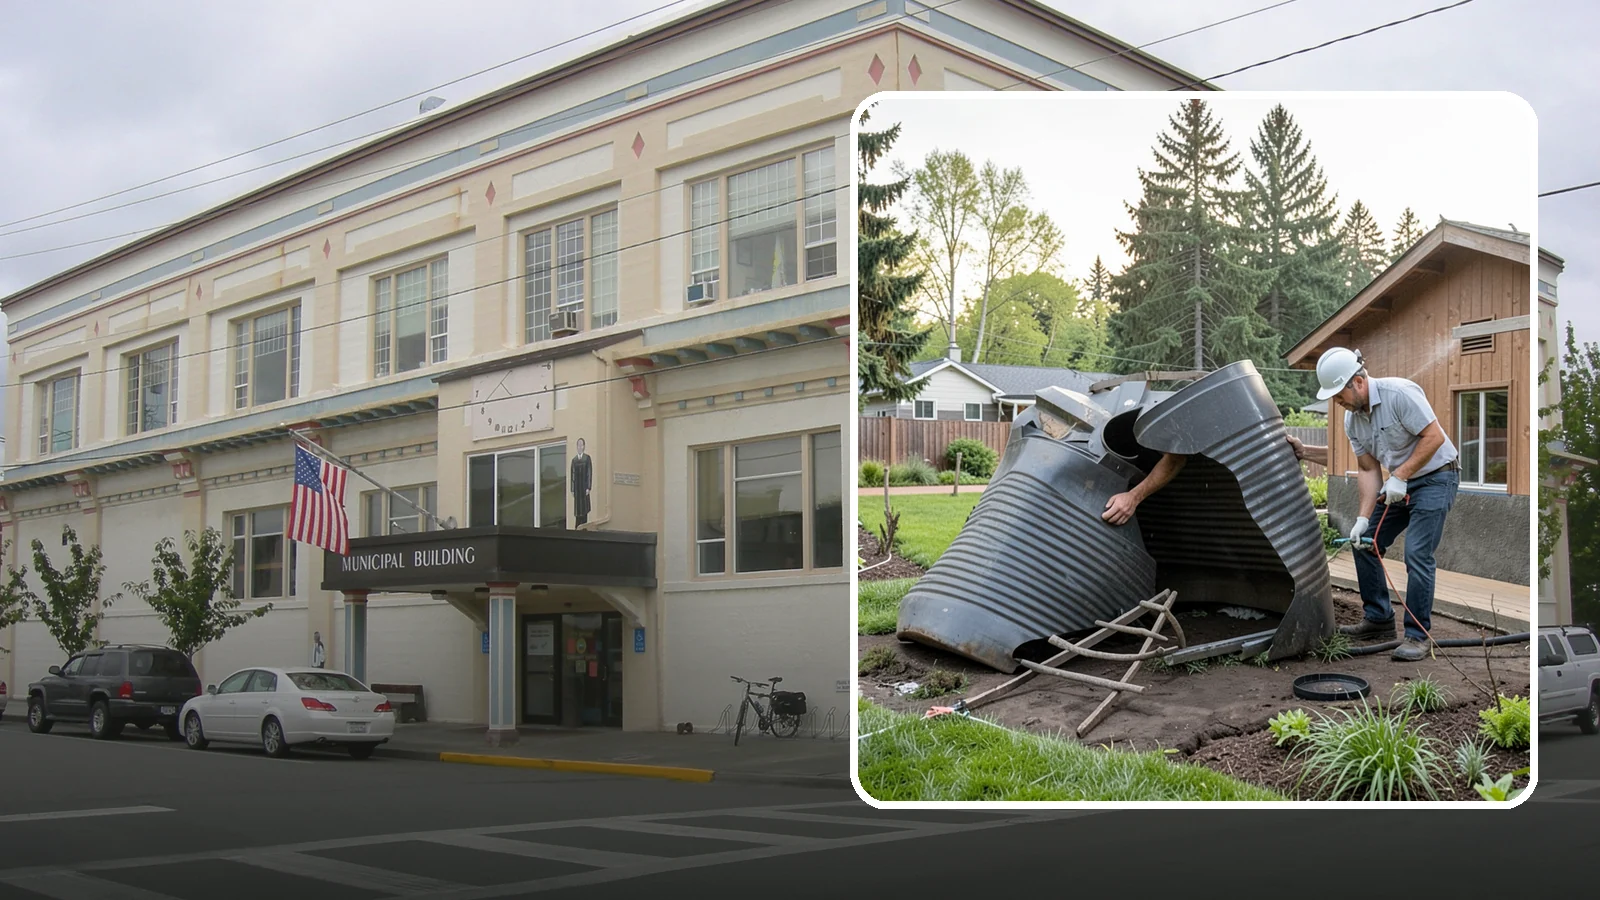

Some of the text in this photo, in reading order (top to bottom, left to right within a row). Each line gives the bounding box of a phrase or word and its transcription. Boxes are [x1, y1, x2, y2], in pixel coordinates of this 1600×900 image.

[508, 425, 513, 433] 12
[342, 546, 475, 572] MUNICIPAL BUILDING
